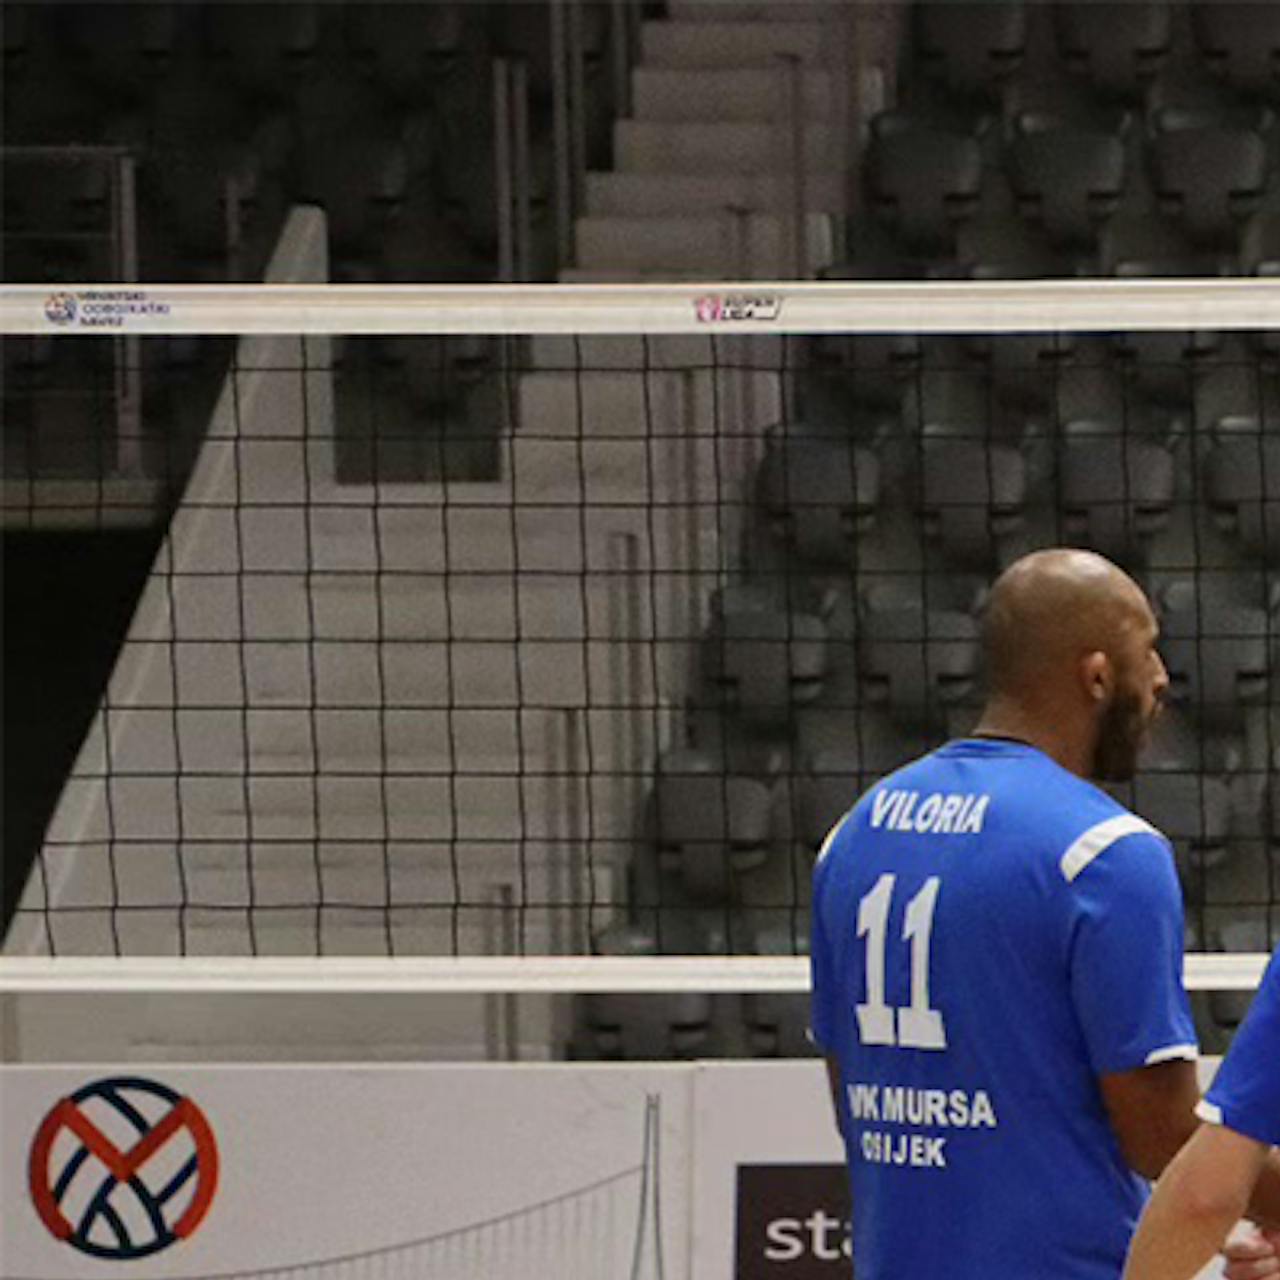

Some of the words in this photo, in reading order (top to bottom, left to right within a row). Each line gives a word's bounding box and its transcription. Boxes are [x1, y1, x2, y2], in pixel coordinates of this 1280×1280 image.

[870, 789, 990, 834] VILORIA
[855, 873, 947, 1048] 11
[882, 1086, 997, 1128] MURSA
[763, 1210, 853, 1260] st
